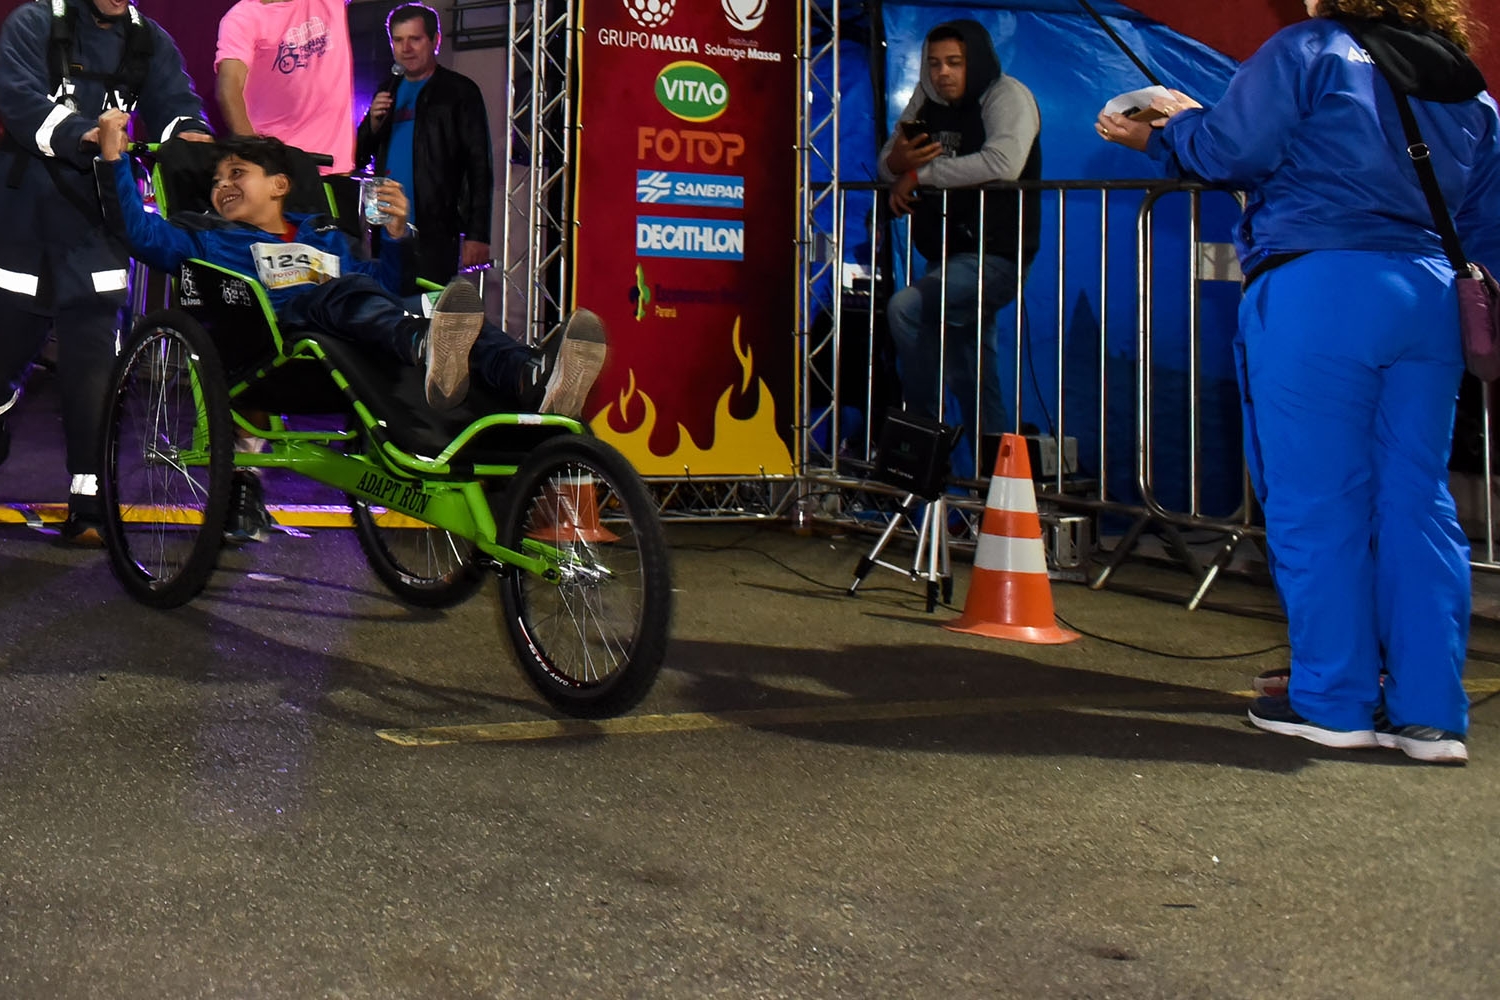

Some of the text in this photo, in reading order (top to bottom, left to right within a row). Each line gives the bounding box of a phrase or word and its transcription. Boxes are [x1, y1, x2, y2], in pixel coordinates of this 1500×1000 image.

[598, 28, 698, 54] GRUPO MASSA
[704, 44, 781, 62] Solange Massa
[660, 75, 728, 106] VITAO
[638, 126, 745, 166] FOTOP
[674, 182, 744, 200] SANEPAR
[637, 223, 743, 254] DECATHLON
[356, 471, 432, 514] ADAPT RUN
